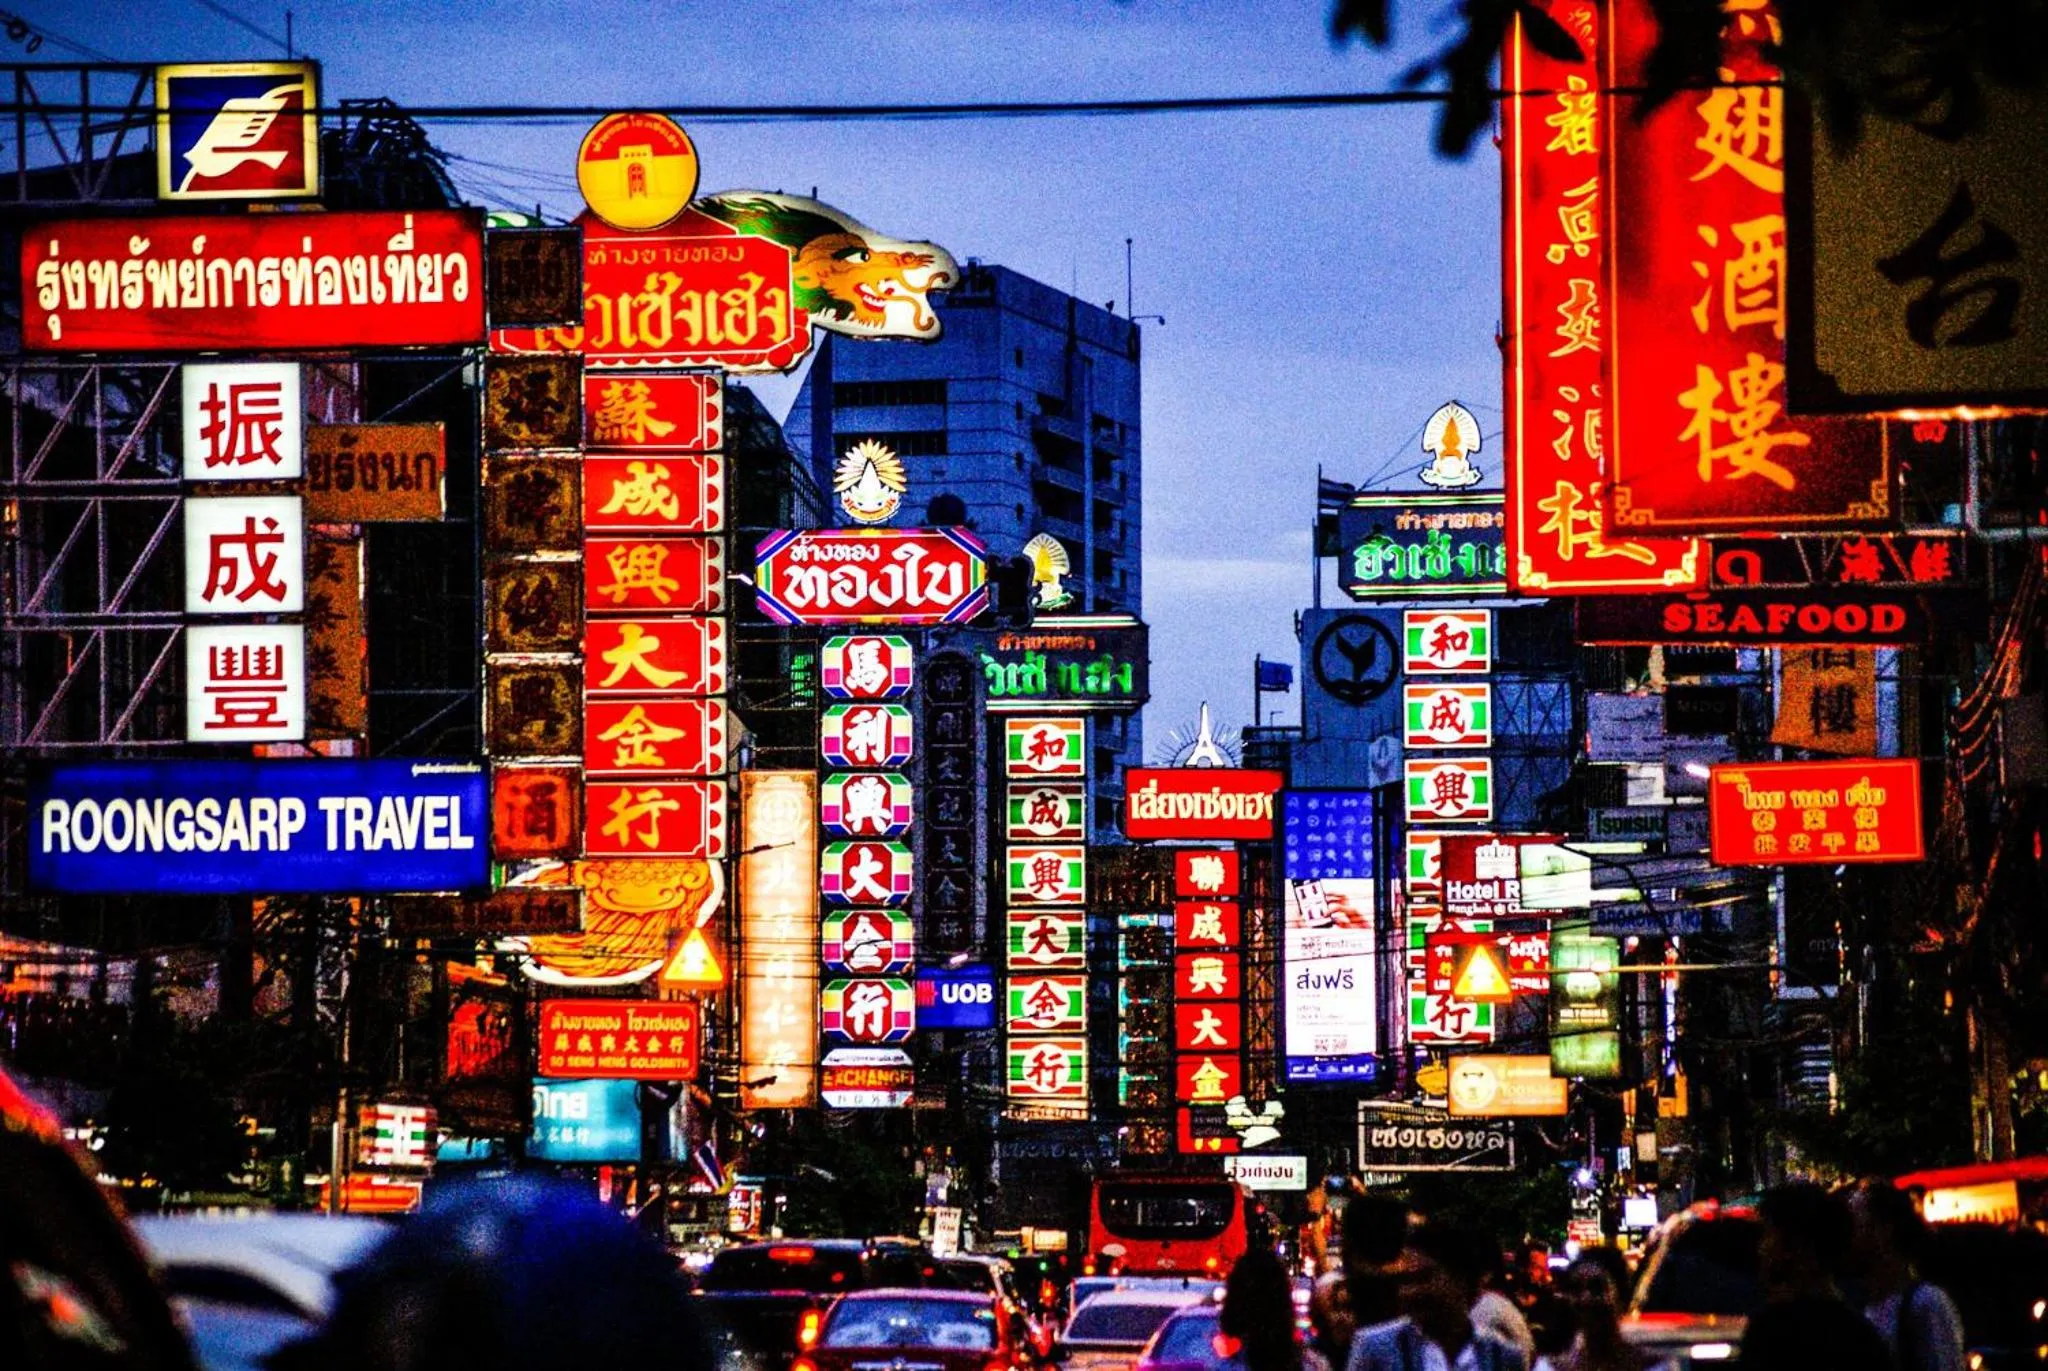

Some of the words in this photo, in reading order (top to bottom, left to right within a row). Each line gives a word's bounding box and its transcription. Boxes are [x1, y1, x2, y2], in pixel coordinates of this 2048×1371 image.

[36, 215, 469, 339] รุ่งทรัพย์การท่องเที่ยว
[201, 382, 289, 729] 振成豐
[783, 542, 965, 608] ทองใบ
[1663, 604, 1907, 633] SEAFOOD
[42, 798, 306, 853] ROONGSARP
[319, 795, 475, 851] TRAVEL
[1426, 622, 1473, 1036] 和成興行
[1027, 728, 1069, 1090] 和成興大金行
[1446, 880, 1500, 900] Hotel
[941, 982, 992, 1004] UOB
[1189, 855, 1229, 1151] 聯成興大金
[1296, 968, 1354, 990] ส่งฟรี
[550, 1056, 564, 1067] SO
[567, 1056, 595, 1067] SENG
[598, 1056, 627, 1068] HENG
[630, 1057, 689, 1069] GOLDSMITH
[823, 1069, 909, 1087] EXCHANGE
